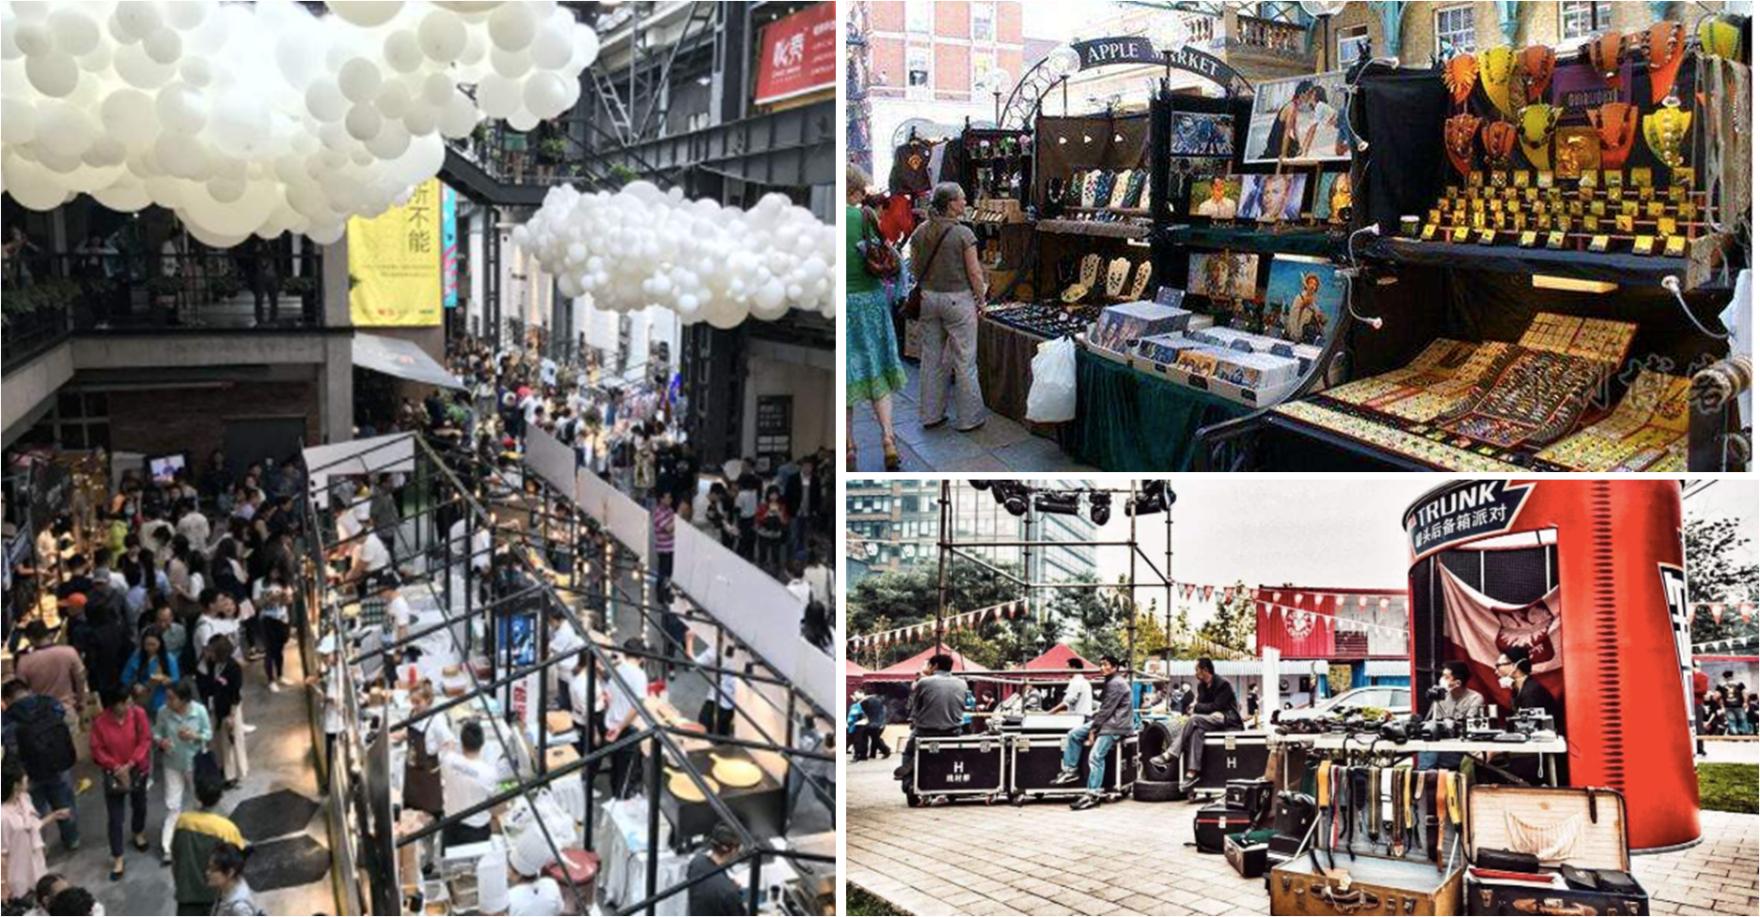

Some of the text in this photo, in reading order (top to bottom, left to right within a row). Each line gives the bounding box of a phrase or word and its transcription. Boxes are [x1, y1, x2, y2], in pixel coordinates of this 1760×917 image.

[1088, 42, 1138, 63] APPLE
[1417, 481, 1498, 526] TRUNK
[953, 761, 964, 773] H
[1226, 756, 1237, 769] H
